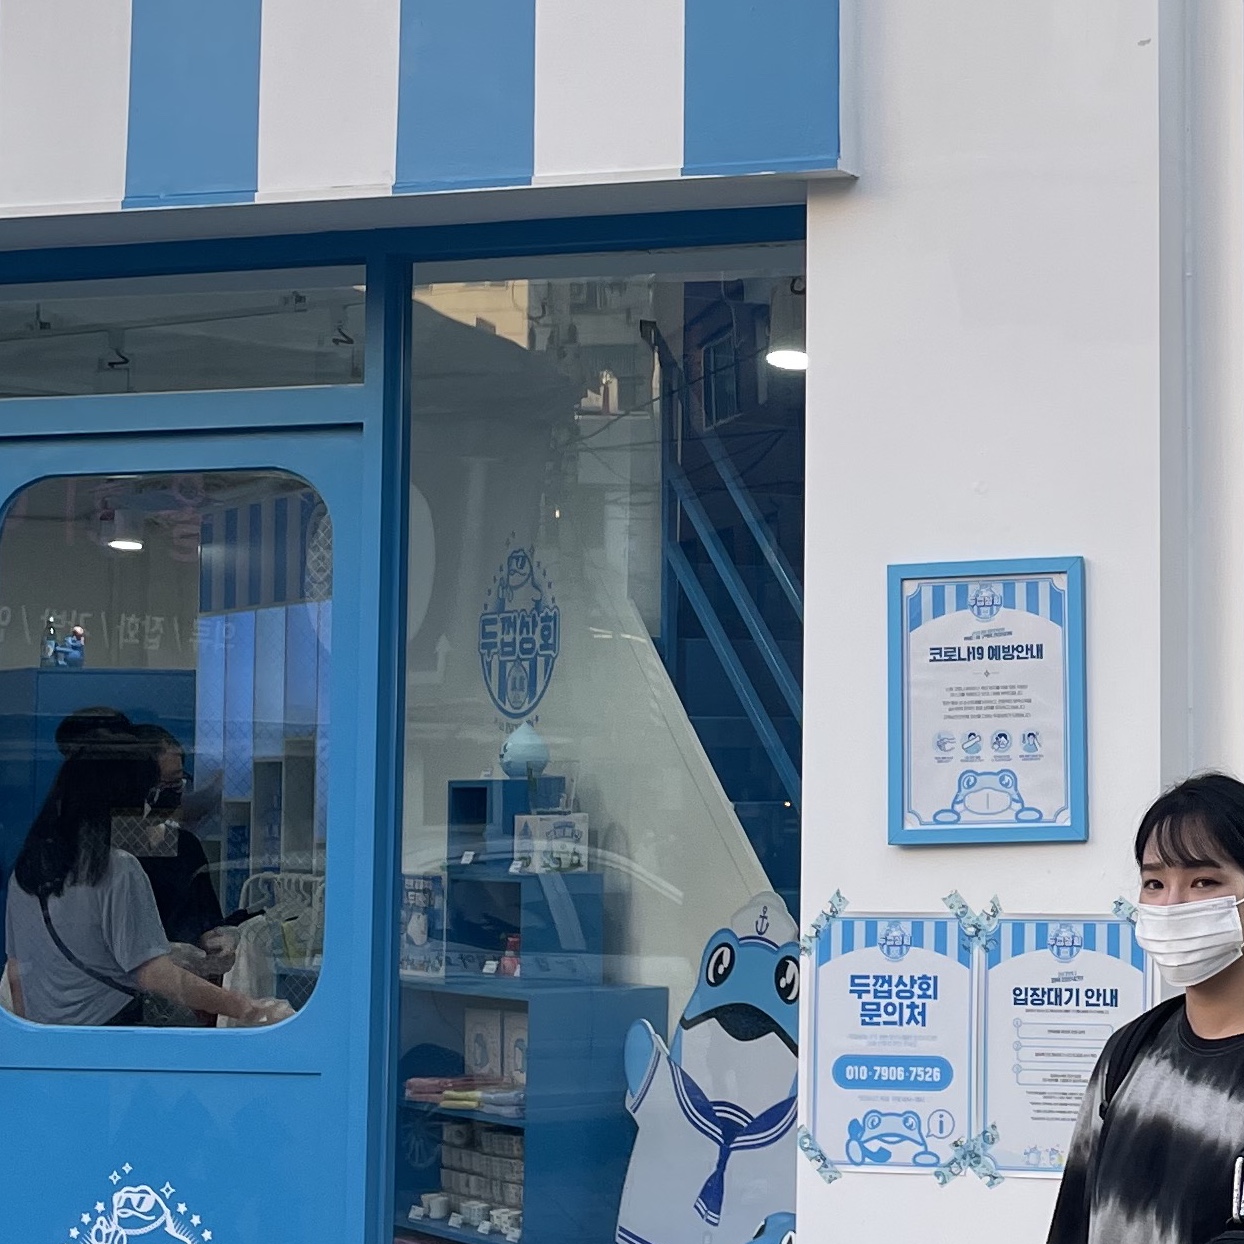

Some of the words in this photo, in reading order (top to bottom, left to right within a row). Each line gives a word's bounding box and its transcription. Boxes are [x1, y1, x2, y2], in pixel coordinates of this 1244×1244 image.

[480, 610, 558, 661] 두껍상회
[928, 645, 985, 663] 코로나19
[987, 643, 1044, 661] 예방안내
[849, 974, 939, 1001] 두껍상회
[1012, 986, 1080, 1007] 입장대기
[1084, 988, 1119, 1008] 안내
[860, 1001, 927, 1027] 문의처
